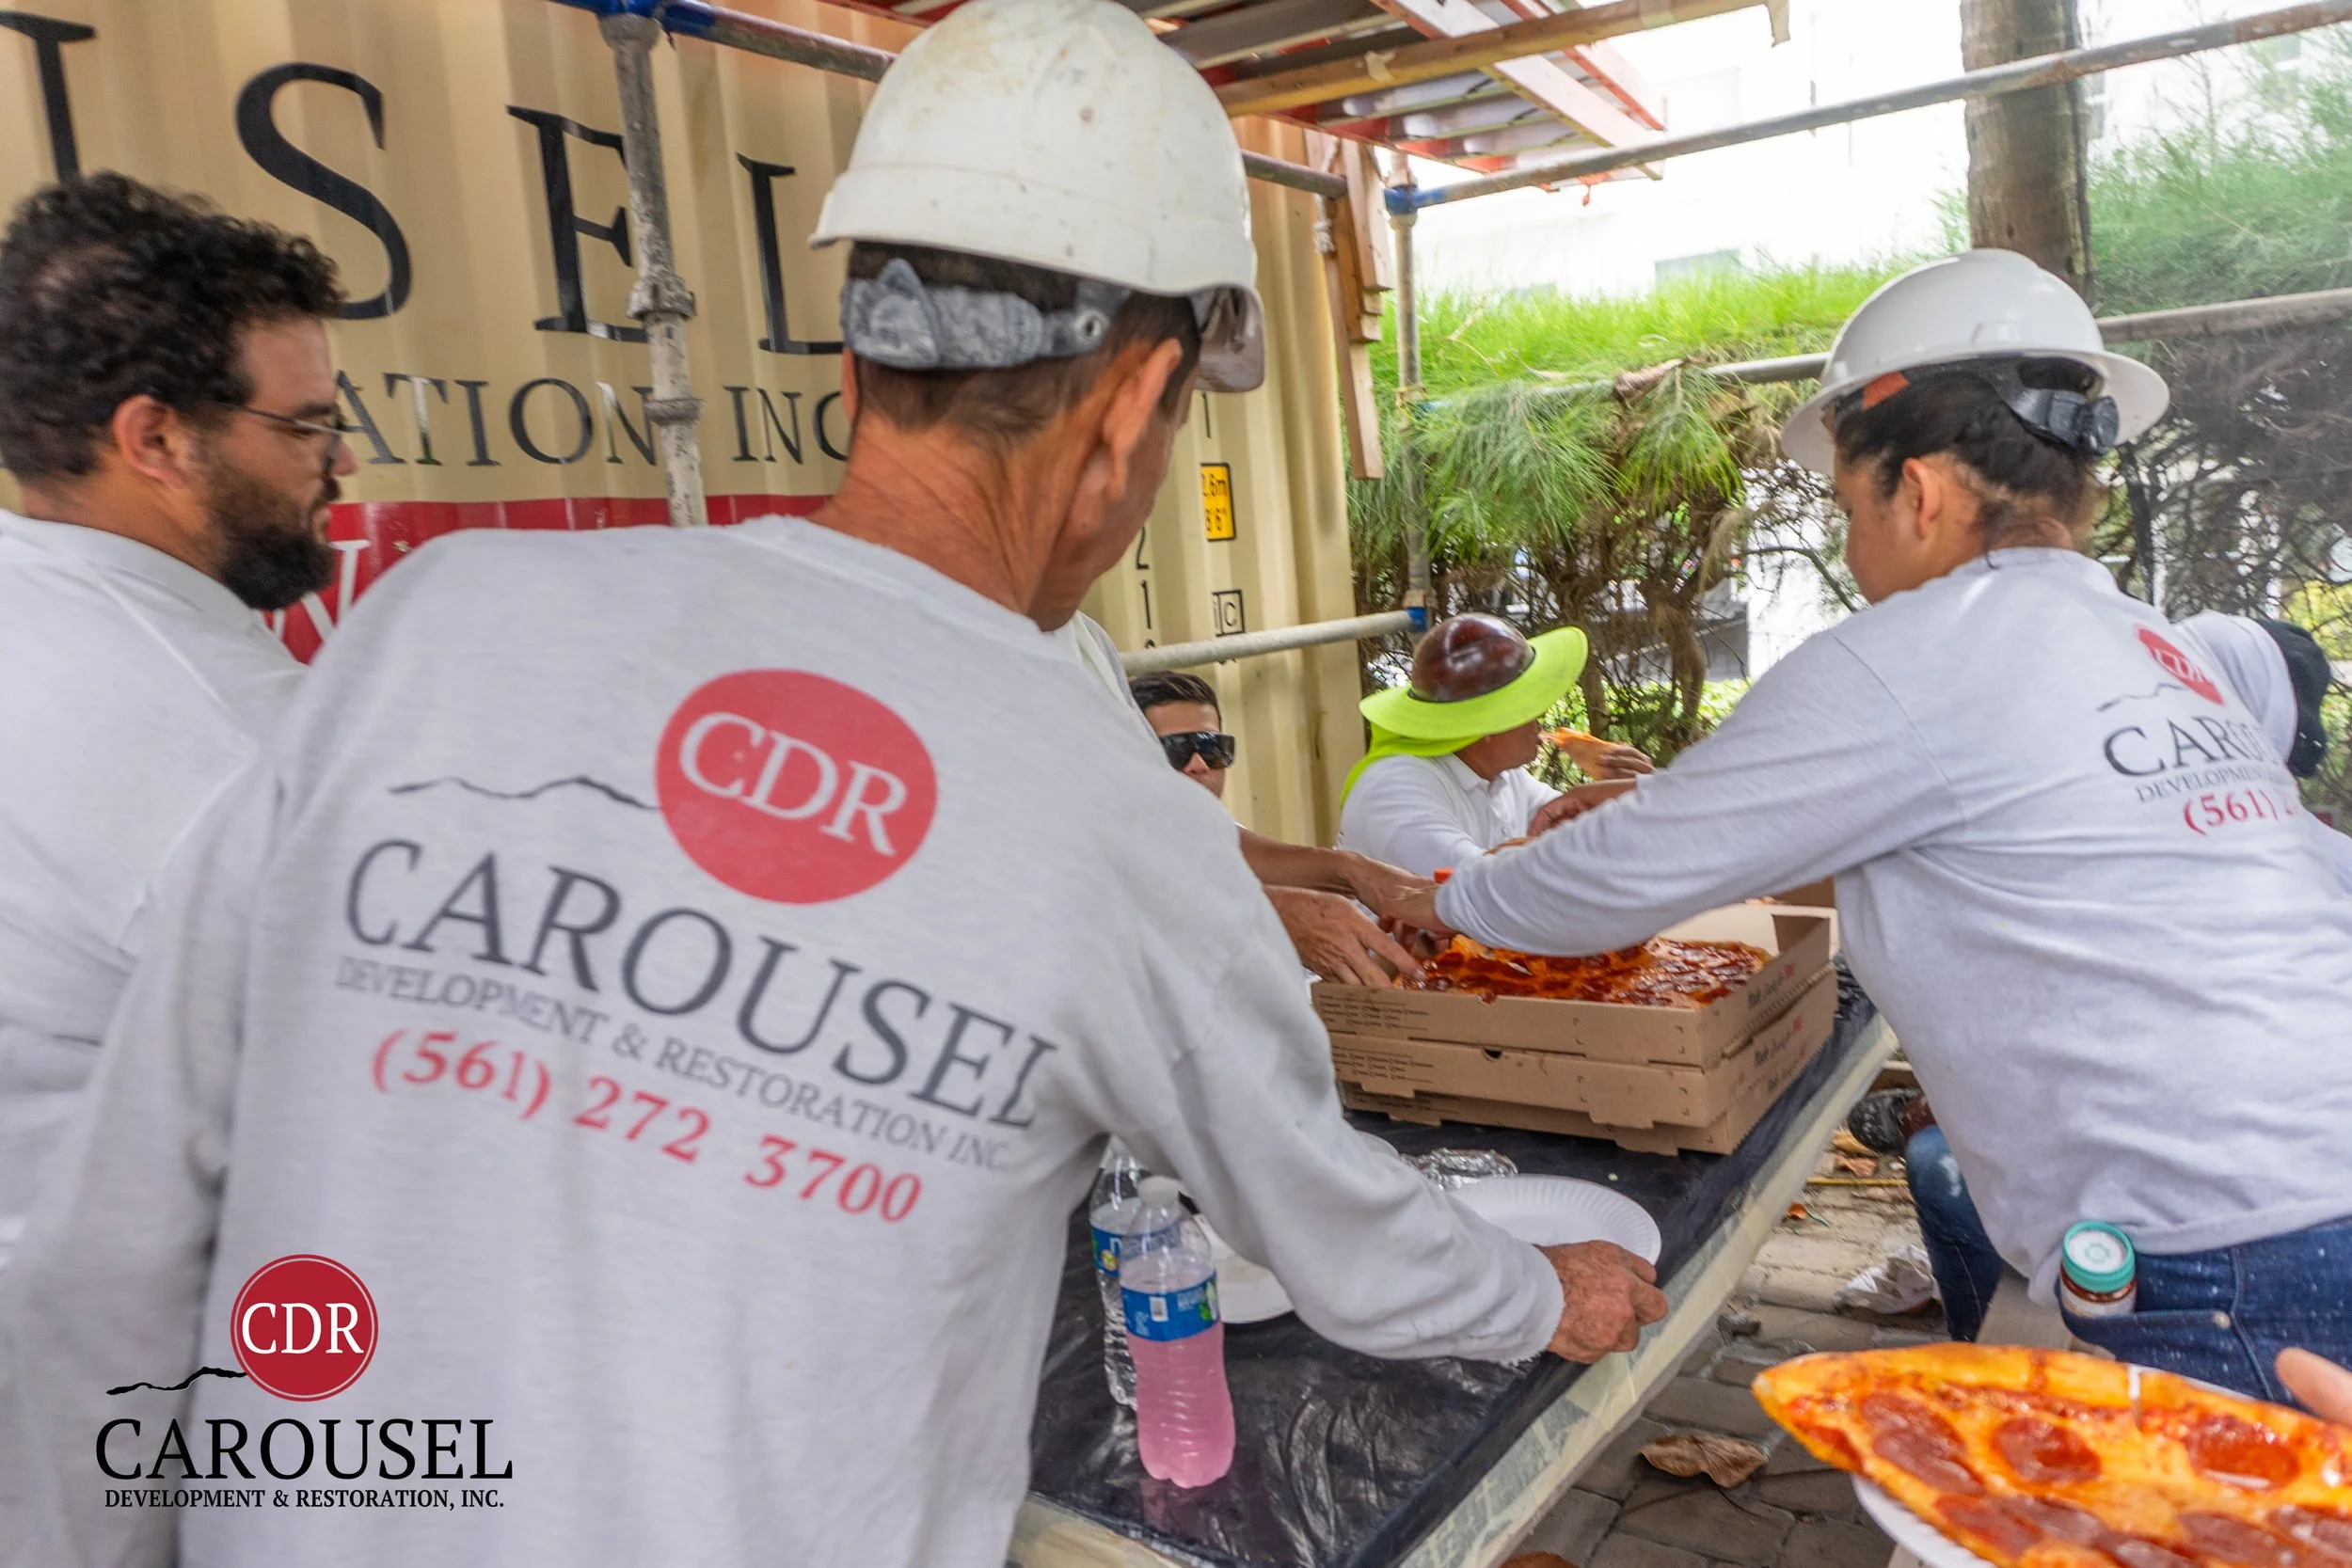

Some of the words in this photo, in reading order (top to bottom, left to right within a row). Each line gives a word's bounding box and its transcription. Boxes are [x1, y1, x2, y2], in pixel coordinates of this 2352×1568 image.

[0, 11, 845, 354] SEL
[336, 370, 658, 467] ATION
[678, 711, 907, 857] CDR
[2183, 787, 2279, 836] (561)
[335, 956, 611, 1044] DEVELOPMENT
[612, 1022, 650, 1061] &
[655, 1036, 946, 1154] RESTORATION
[345, 838, 1058, 1130] CAROUSEL
[371, 1028, 552, 1121] (561)
[572, 1074, 711, 1164] 272
[742, 1132, 923, 1224] 3700
